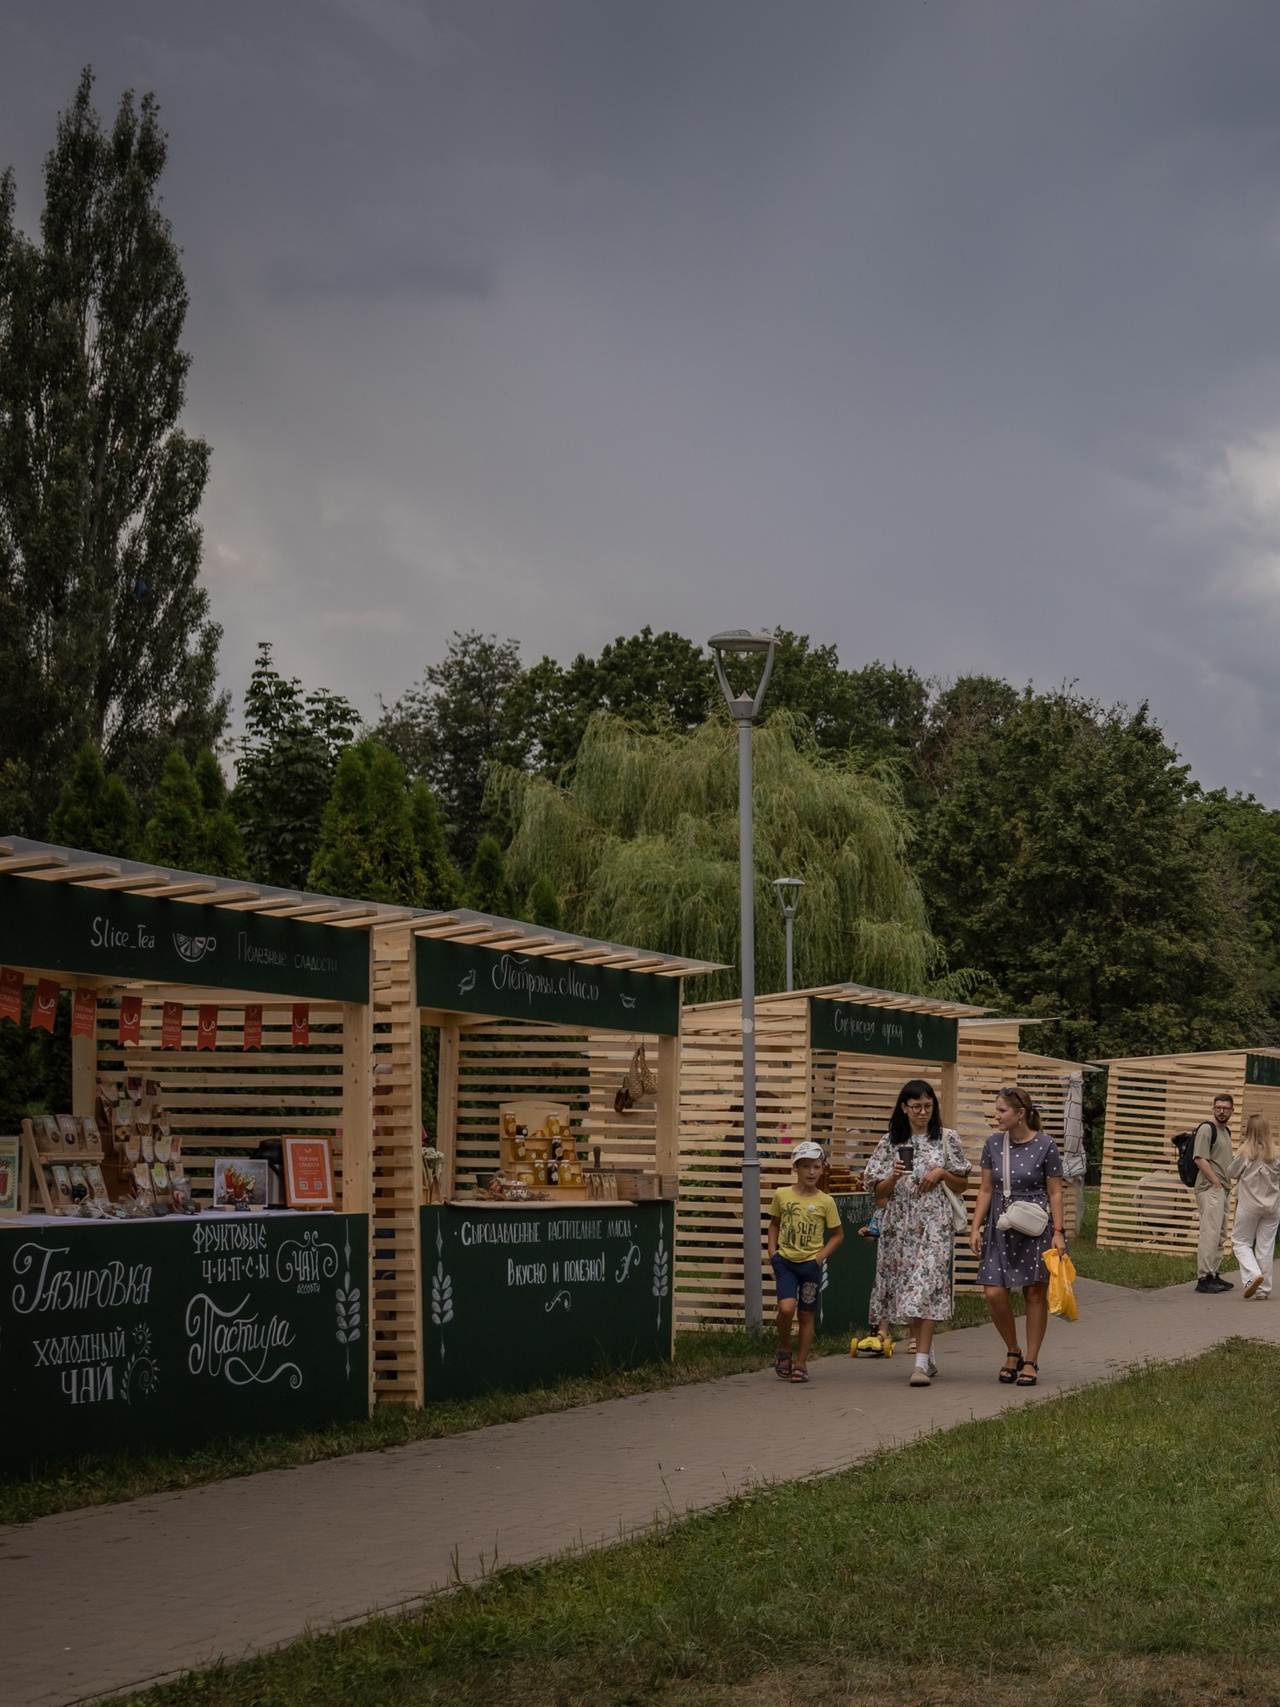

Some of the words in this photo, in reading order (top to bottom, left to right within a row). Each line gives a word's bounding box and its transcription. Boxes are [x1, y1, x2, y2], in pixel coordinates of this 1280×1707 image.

[237, 931, 287, 967] Полезные
[192, 1223, 268, 1255] ФРУКТОВЫЕ
[796, 1222, 818, 1235] SURF
[799, 1235, 813, 1247] UP
[291, 1246, 321, 1282] ЧАЙ
[32, 1325, 127, 1367] ХОЛОДНЫЙ
[60, 1361, 115, 1405] ЧАЙ
